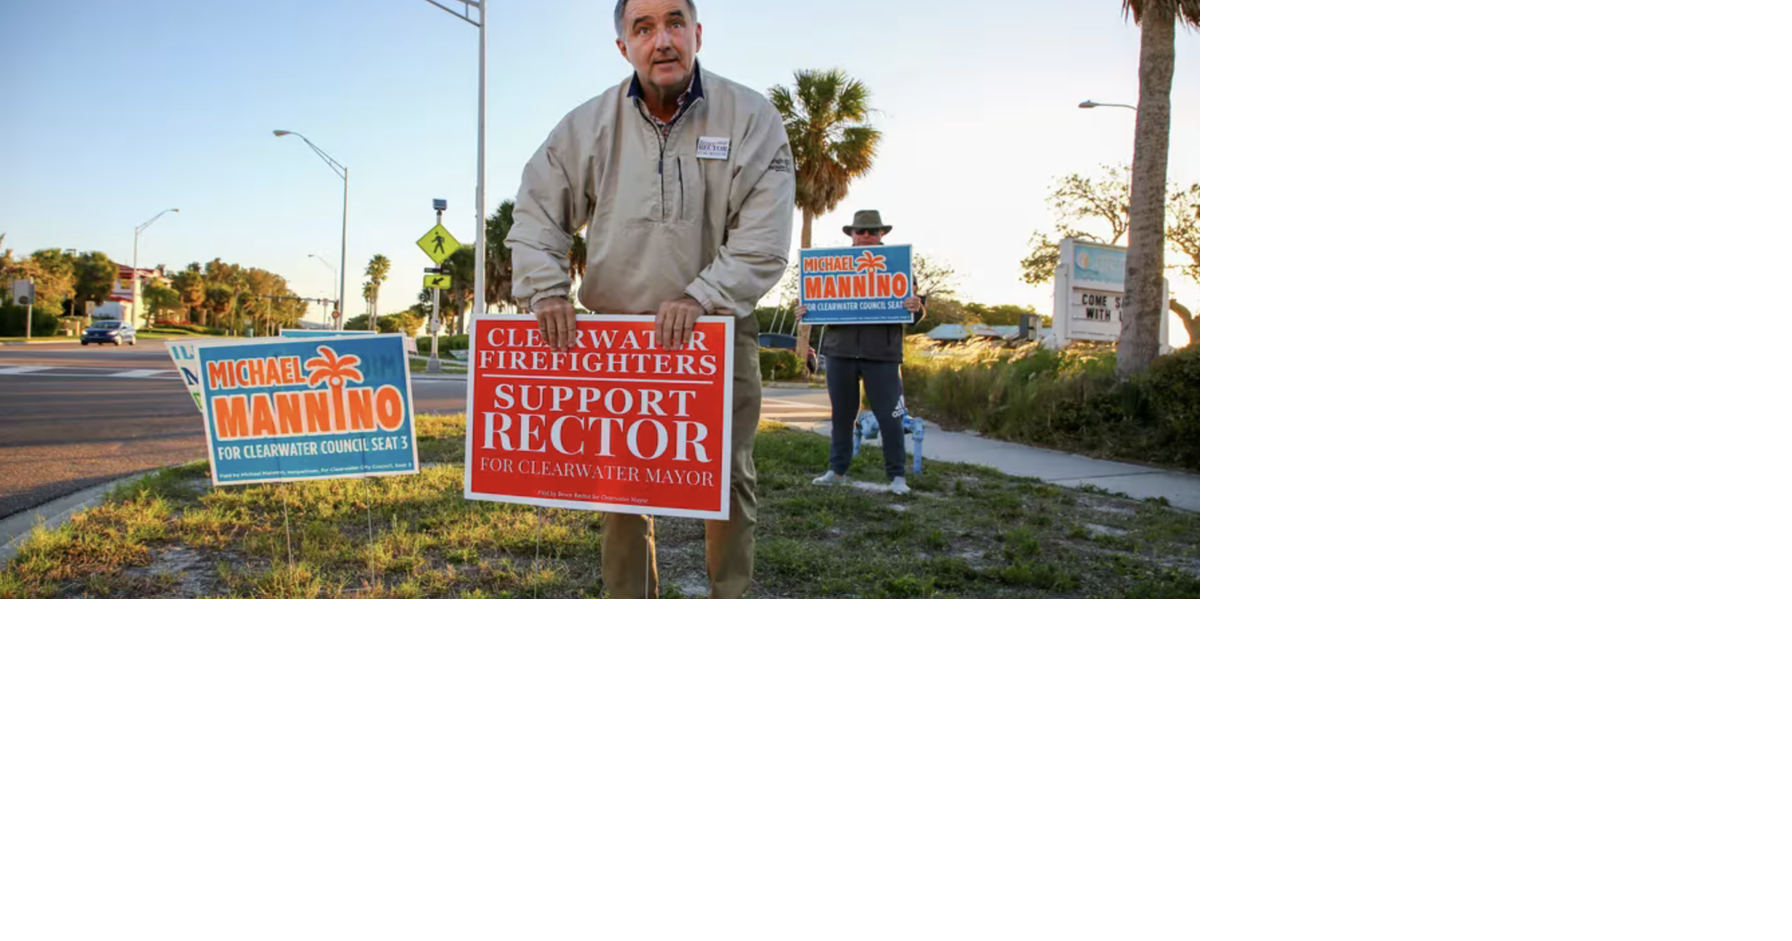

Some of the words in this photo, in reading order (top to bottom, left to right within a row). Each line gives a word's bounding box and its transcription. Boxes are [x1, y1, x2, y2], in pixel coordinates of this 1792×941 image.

[803, 255, 855, 273] MICHAEL
[804, 273, 908, 300] MANNINO
[817, 301, 858, 311] CLEARWATER
[860, 301, 887, 310] COUNCIL
[1082, 293, 1107, 307] COME
[1086, 307, 1111, 320] WITH
[487, 327, 709, 351] CLERWATR
[207, 356, 307, 389] MICHAEL
[478, 350, 717, 376] FIREFIGHTERS
[212, 385, 405, 440] MANNINO
[494, 384, 696, 417] SUPPORT
[217, 446, 241, 460] FOR
[243, 441, 318, 459] CLEARWATER
[321, 438, 370, 454] COUNCIL
[371, 436, 398, 451] SEAT
[400, 435, 408, 450] 3
[481, 411, 712, 463] RECTOR
[480, 457, 514, 473] FOR
[518, 459, 640, 482] CLEARWATER
[645, 468, 714, 487] MAYOR
